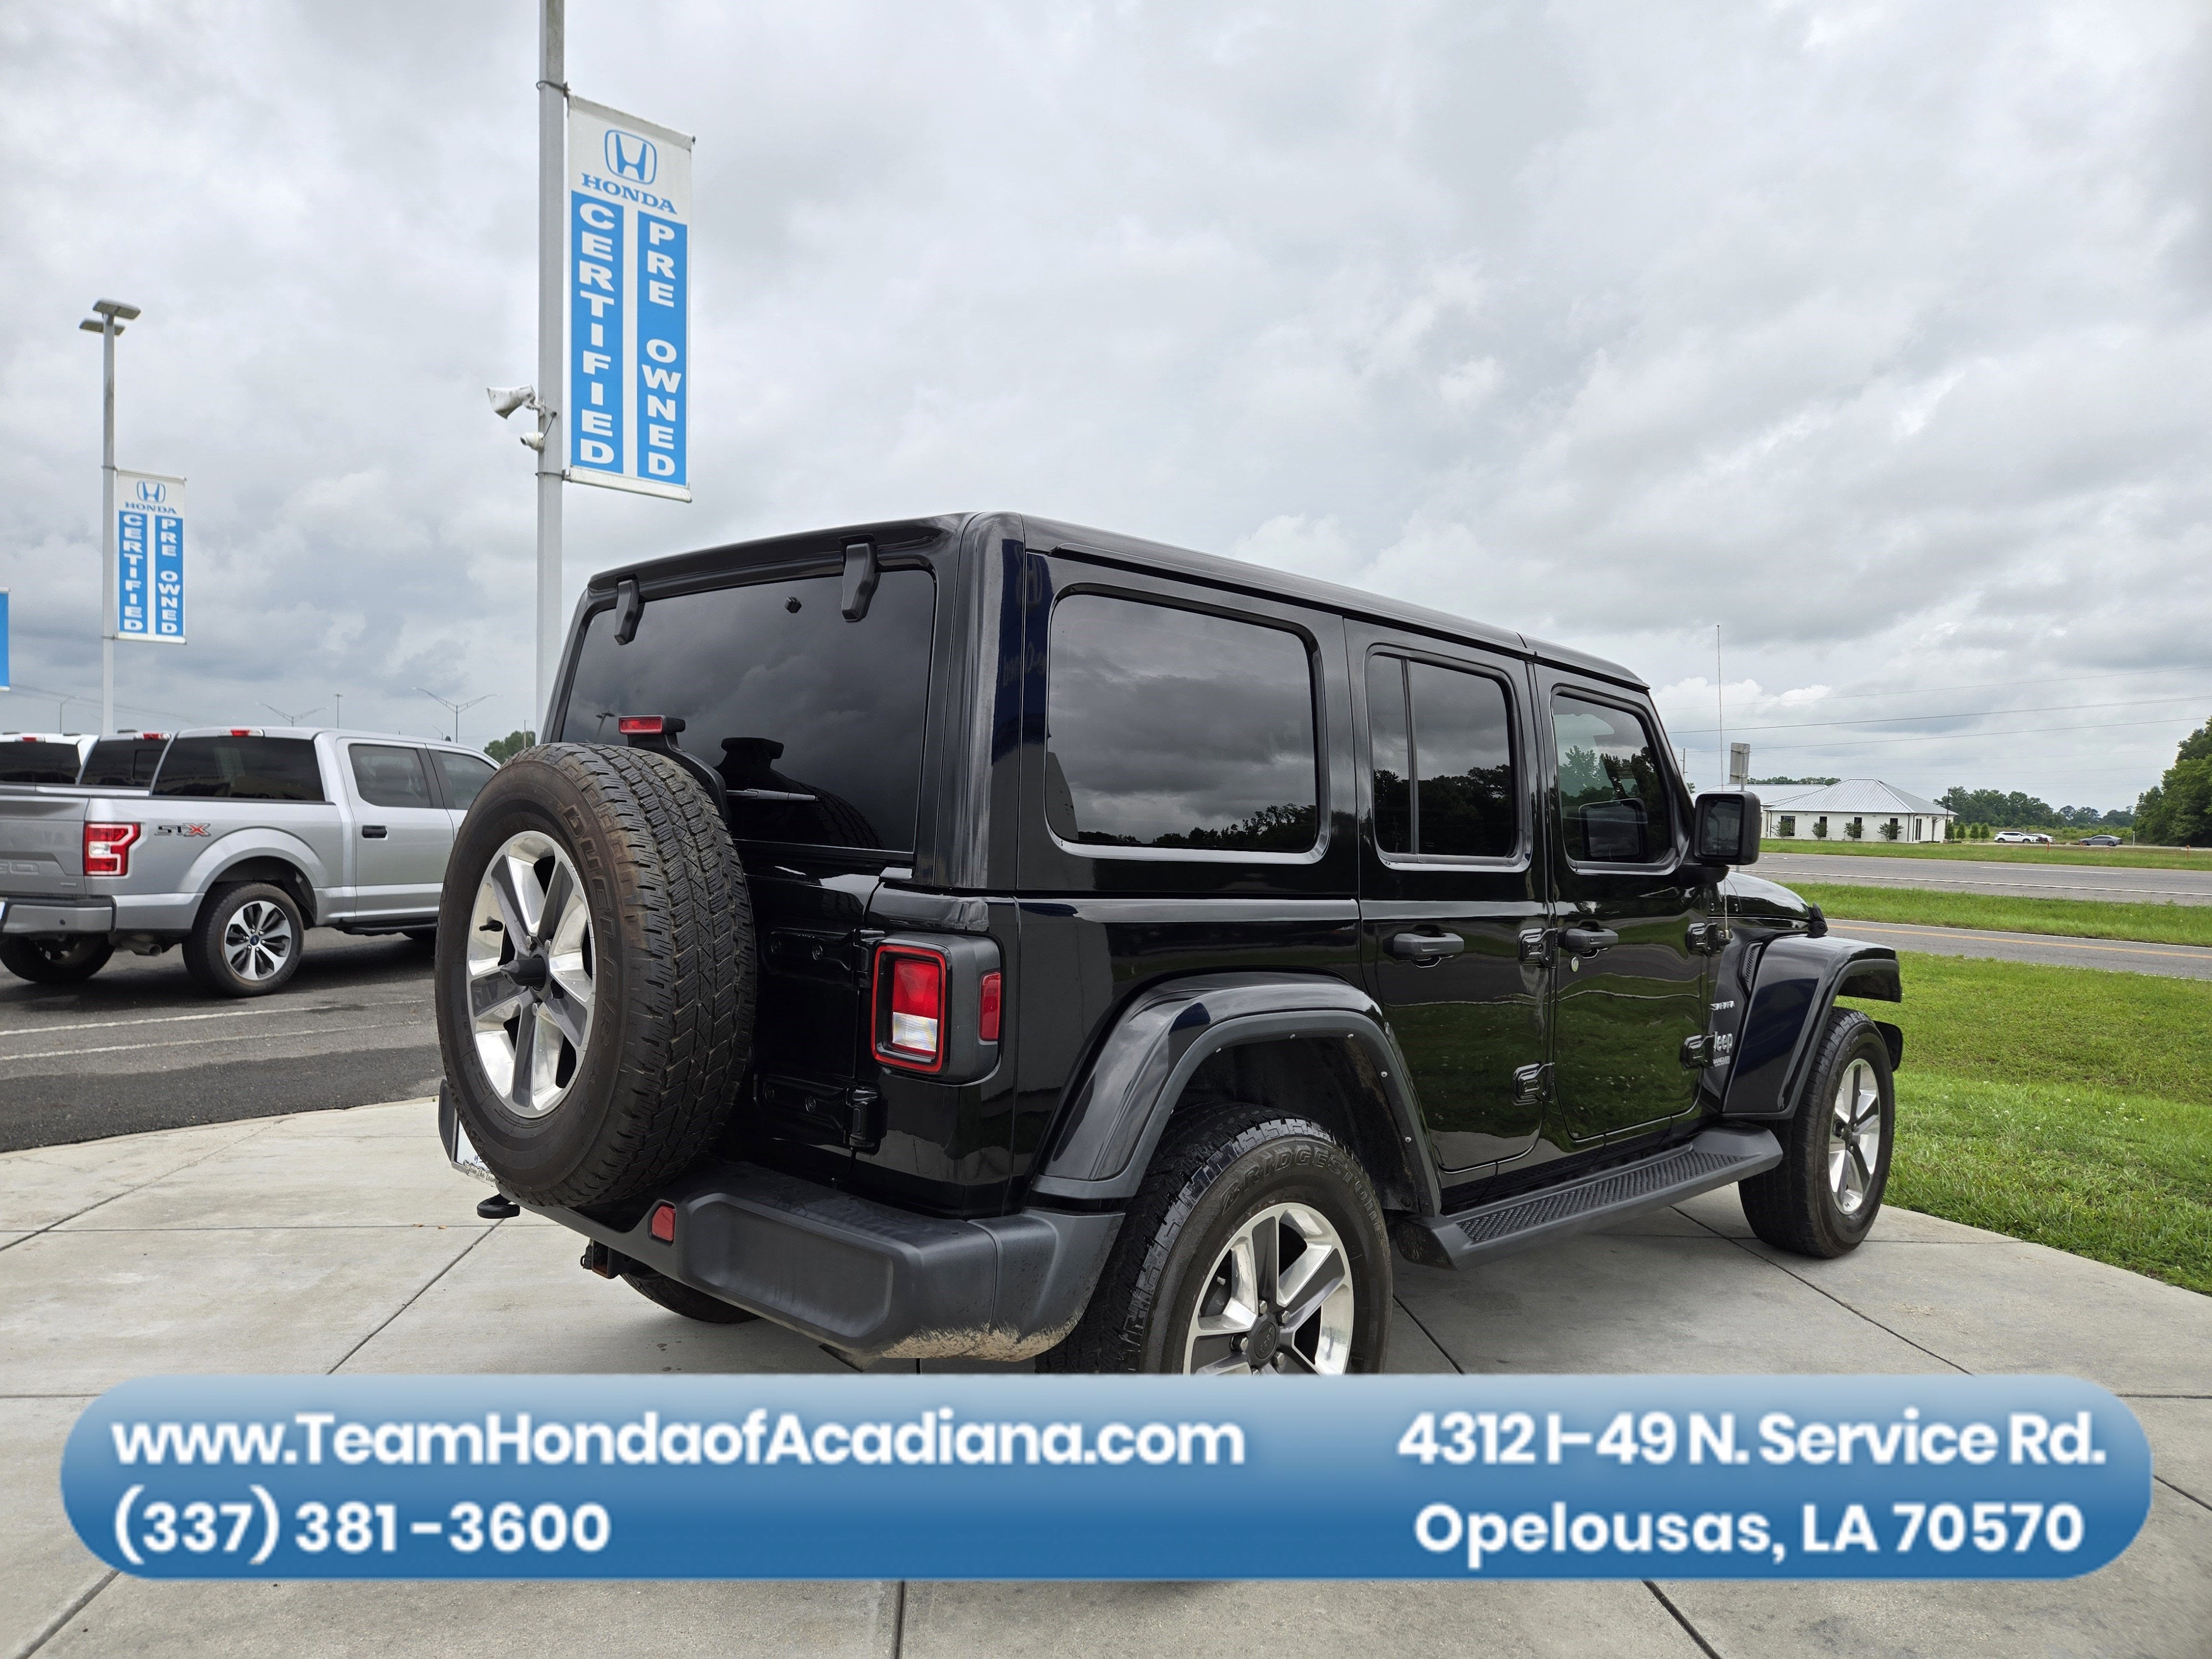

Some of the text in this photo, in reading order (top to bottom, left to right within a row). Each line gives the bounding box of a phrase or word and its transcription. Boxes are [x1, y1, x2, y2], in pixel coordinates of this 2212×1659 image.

[581, 172, 678, 215] HONDA
[578, 201, 615, 466] CERTIFIED
[641, 220, 682, 477] PRE OWNED
[124, 501, 177, 514] HONDA
[123, 514, 143, 632] CERTIFIED
[158, 518, 181, 634] PRE OWNED
[154, 822, 212, 837] STX
[1713, 1031, 1733, 1053] Jeep
[1219, 1145, 1384, 1243] BRIDGESTONE
